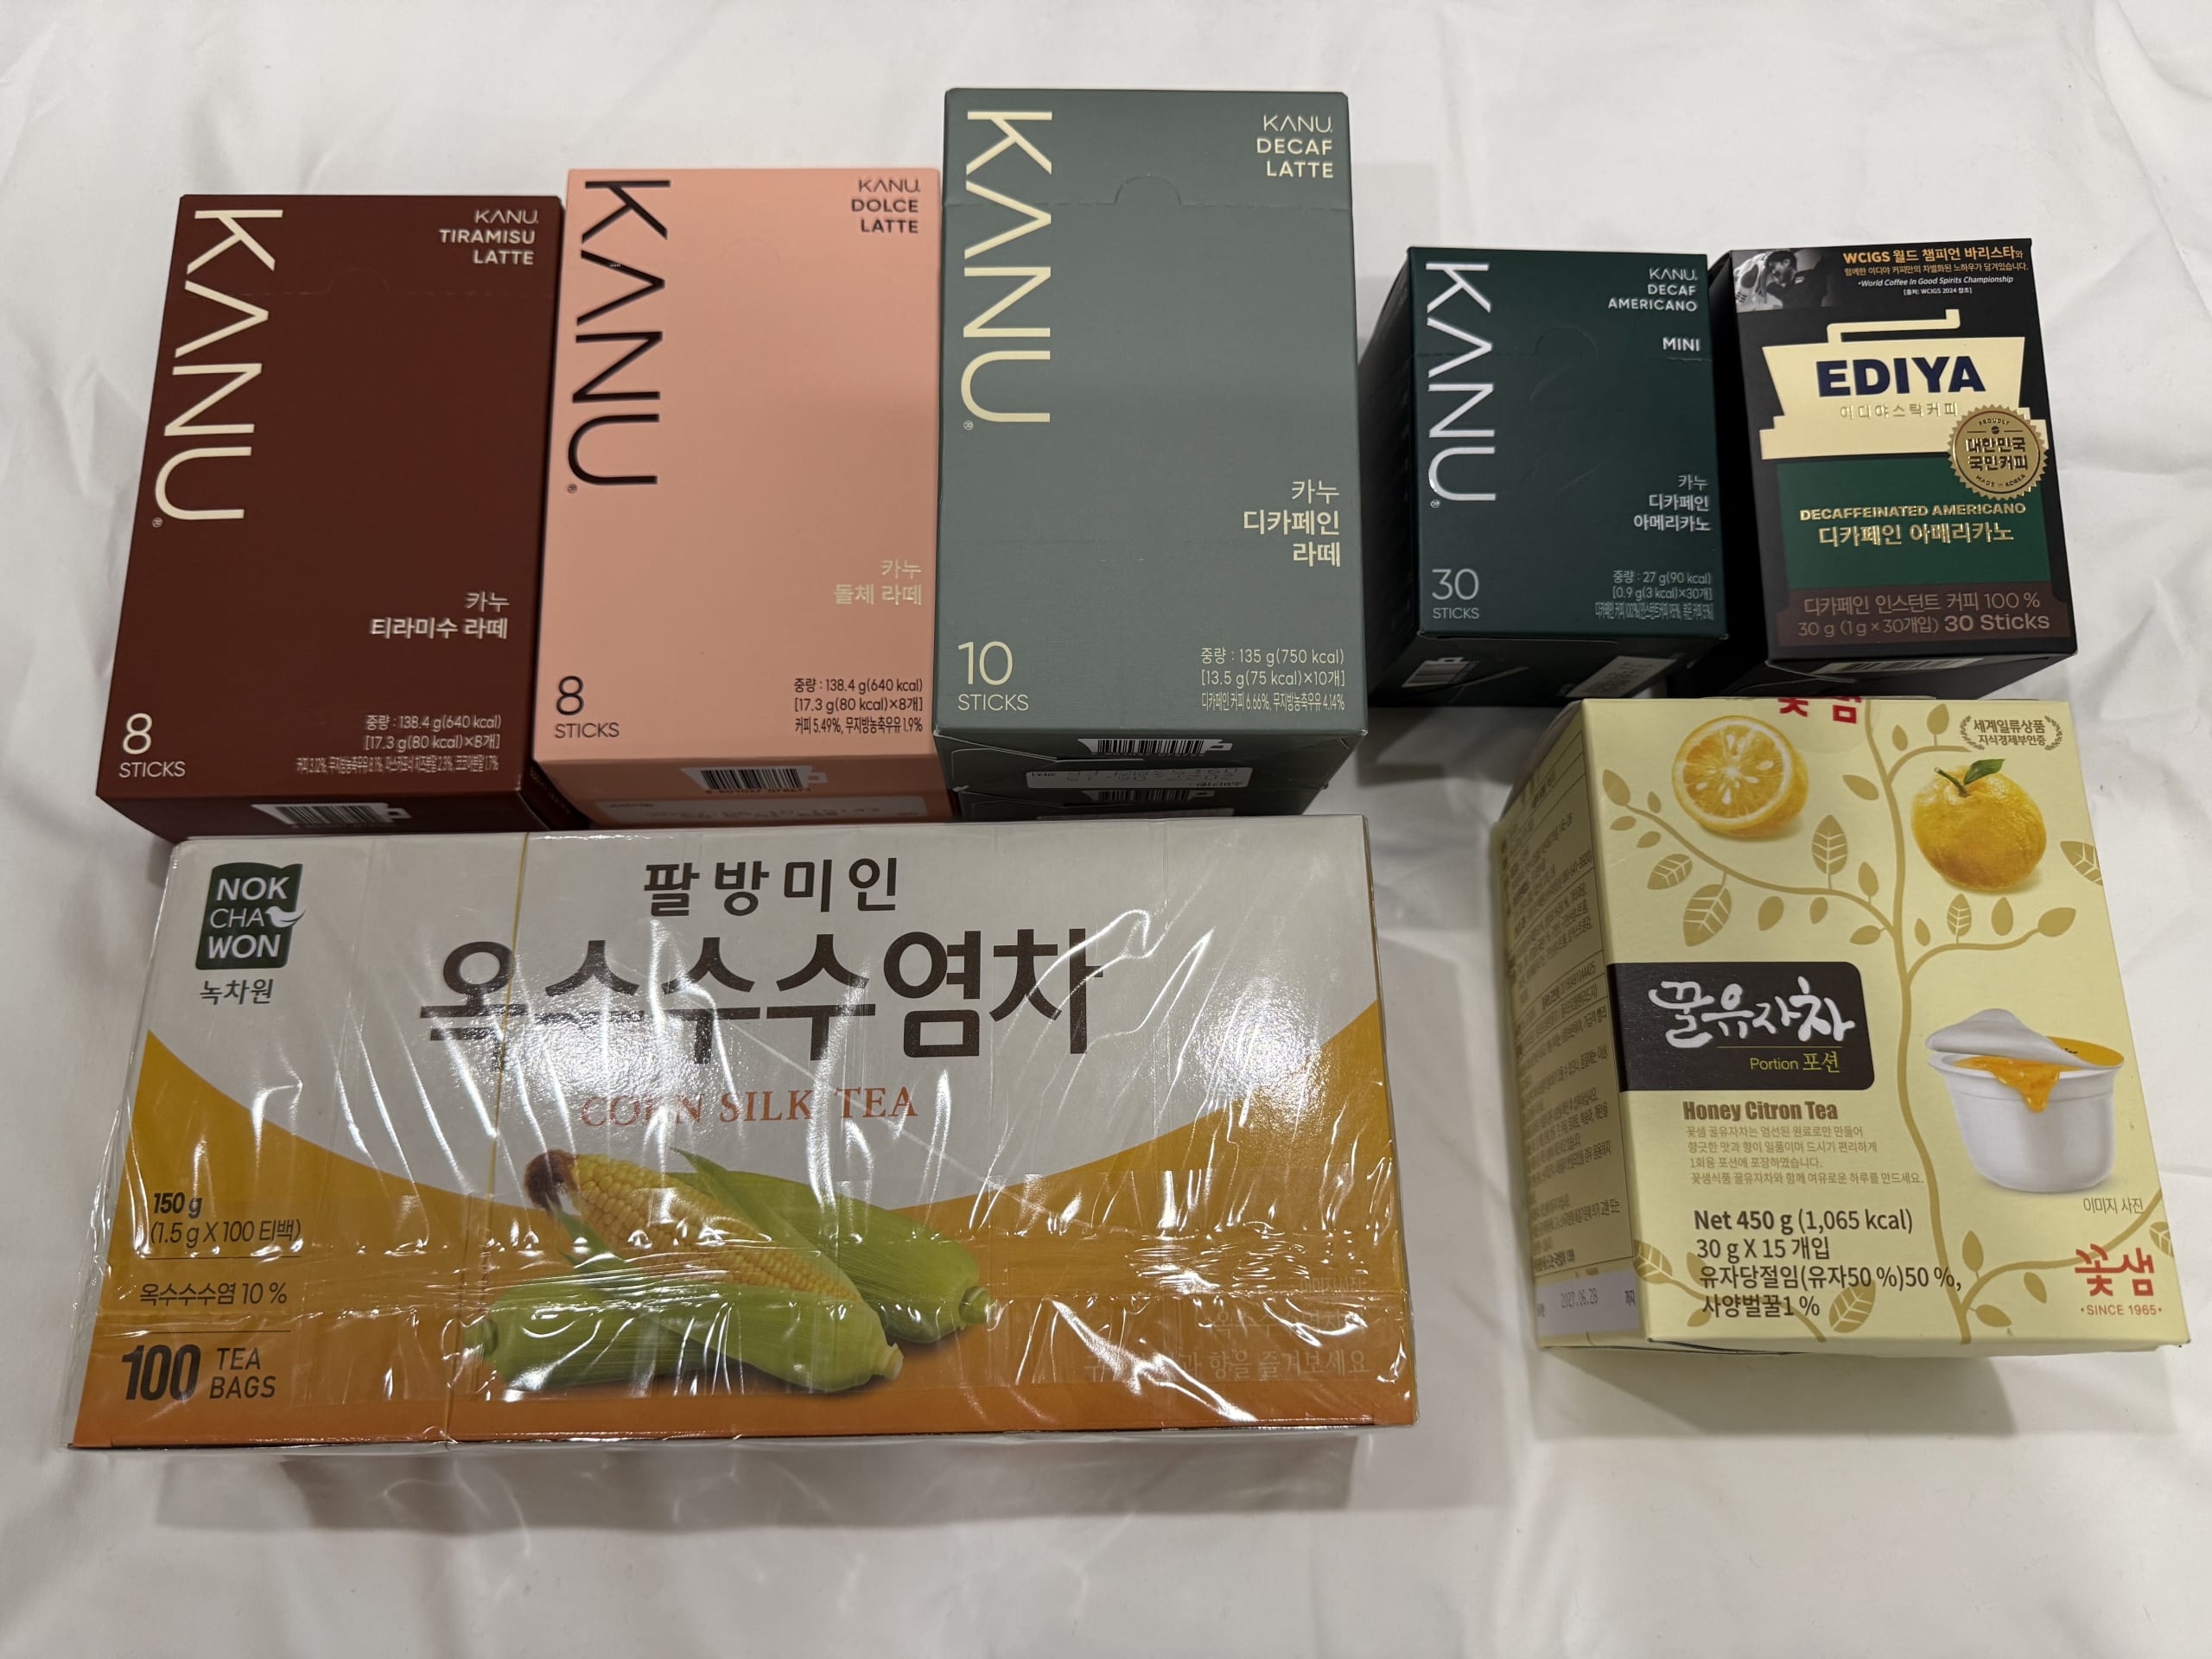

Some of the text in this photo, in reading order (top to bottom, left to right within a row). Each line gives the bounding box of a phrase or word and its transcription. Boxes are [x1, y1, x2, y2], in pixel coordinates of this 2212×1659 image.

[1263, 114, 1332, 133] KANU
[1256, 138, 1333, 156] DECAF
[1267, 162, 1334, 179] LATTE
[859, 179, 918, 193] KANU
[852, 199, 918, 213] DOLCE
[474, 209, 537, 224] KANU
[861, 219, 918, 233] LATTE
[440, 229, 536, 245] TIRAMISU
[474, 250, 534, 265] LATTE
[1843, 245, 2024, 264] WCIGS 월드 챔피언 바리스타와
[960, 111, 1052, 423] KANU
[1649, 268, 1694, 281] KANU
[1648, 284, 1696, 296] DECAF
[1885, 275, 2013, 286] Coffee Good Spirits Championship
[1608, 298, 1697, 312] AMERICANO
[568, 181, 671, 486] KANU
[1662, 337, 1700, 352] MINI
[156, 209, 283, 520] KANU
[1426, 263, 1497, 502] KANU
[1816, 356, 1986, 397] EDIYA
[1966, 437, 2025, 454] 대한민국
[1968, 455, 2028, 471] 국민커피
[1292, 479, 1339, 504] 카누
[1678, 474, 1707, 491] 카누
[1649, 493, 1710, 512] 디카페인
[1800, 503, 2026, 521] DECAFFEINATED AMERICANO
[1244, 509, 1339, 536] 디카페인
[1634, 514, 1711, 532] 아메리카노
[1819, 522, 2013, 548] 디카페인 아메리카노
[1293, 541, 1340, 567] 라떼
[881, 558, 922, 579] 카누
[1612, 570, 1711, 586] 중량 27 g(90 kcal)
[1432, 568, 1479, 601] 30
[465, 591, 510, 613] 카누
[834, 584, 922, 606] 돌체 라떼
[1804, 592, 2040, 616] 디카페인 인스턴트 커피 100 %
[1433, 607, 1479, 620] STICKS
[370, 617, 508, 639] 티라미수 라떼
[1798, 622, 1818, 636] 30
[1944, 615, 1974, 632] 30
[1980, 613, 2050, 632] Sticks
[957, 641, 1014, 686] 10
[1200, 647, 1344, 667] 중량 135 g(750 kcal)
[794, 677, 923, 695] 중량 138.4 g(640 kcal)
[1201, 670, 1231, 686] [13.5
[1236, 670, 1267, 690] g(75
[556, 676, 585, 715] 8
[957, 693, 1029, 711] STICKS
[794, 697, 823, 712] [17.3
[826, 697, 856, 715] g(80
[123, 713, 152, 754] 8
[366, 715, 502, 733] 중량 138.4 g(640 kcal)
[554, 722, 620, 739] STICKS
[795, 717, 811, 734] 커피
[814, 717, 843, 734] 5.49%,
[846, 716, 901, 734] 무지방농축우유
[1974, 720, 2045, 734] 세계일류상품
[365, 735, 429, 752] [17.3 g(80
[1978, 734, 2046, 746] 지식경제부인증
[119, 761, 186, 778] STICKS
[216, 876, 290, 901] NOK
[209, 906, 265, 929] CHA
[207, 934, 281, 960] WON
[200, 979, 274, 1005] 녹차원
[420, 928, 1105, 1070] 옥수수수염차
[1648, 976, 1856, 1049] 꿀유자차
[1750, 1052, 1840, 1074] Portion 포션
[719, 1085, 918, 1123] SILK TEA
[1682, 1100, 1838, 1122] Honey Citron Tea
[1807, 1141, 1836, 1154] 드시기
[1838, 1141, 1878, 1153] 편리하게
[1786, 1172, 1805, 1185] 함께
[1808, 1172, 1847, 1185] 여유로운
[1850, 1172, 1878, 1185] 하루를
[153, 1192, 202, 1218] 150 g
[2083, 1198, 2144, 1214] 이미지 사진
[1694, 1208, 1912, 1236] Net 450 g (1,065 kcal)
[150, 1222, 183, 1245] (1.5
[187, 1226, 199, 1249] g
[223, 1221, 255, 1243] 100
[259, 1218, 302, 1243] 티백)
[1696, 1236, 1830, 1263] 30 g X 15 개입
[2075, 1243, 2154, 1296] 꽃샘
[140, 1282, 287, 1306] 옥수수수염 10 %
[122, 1344, 261, 1401] 100 TEA
[209, 1376, 276, 1399] BAGS
